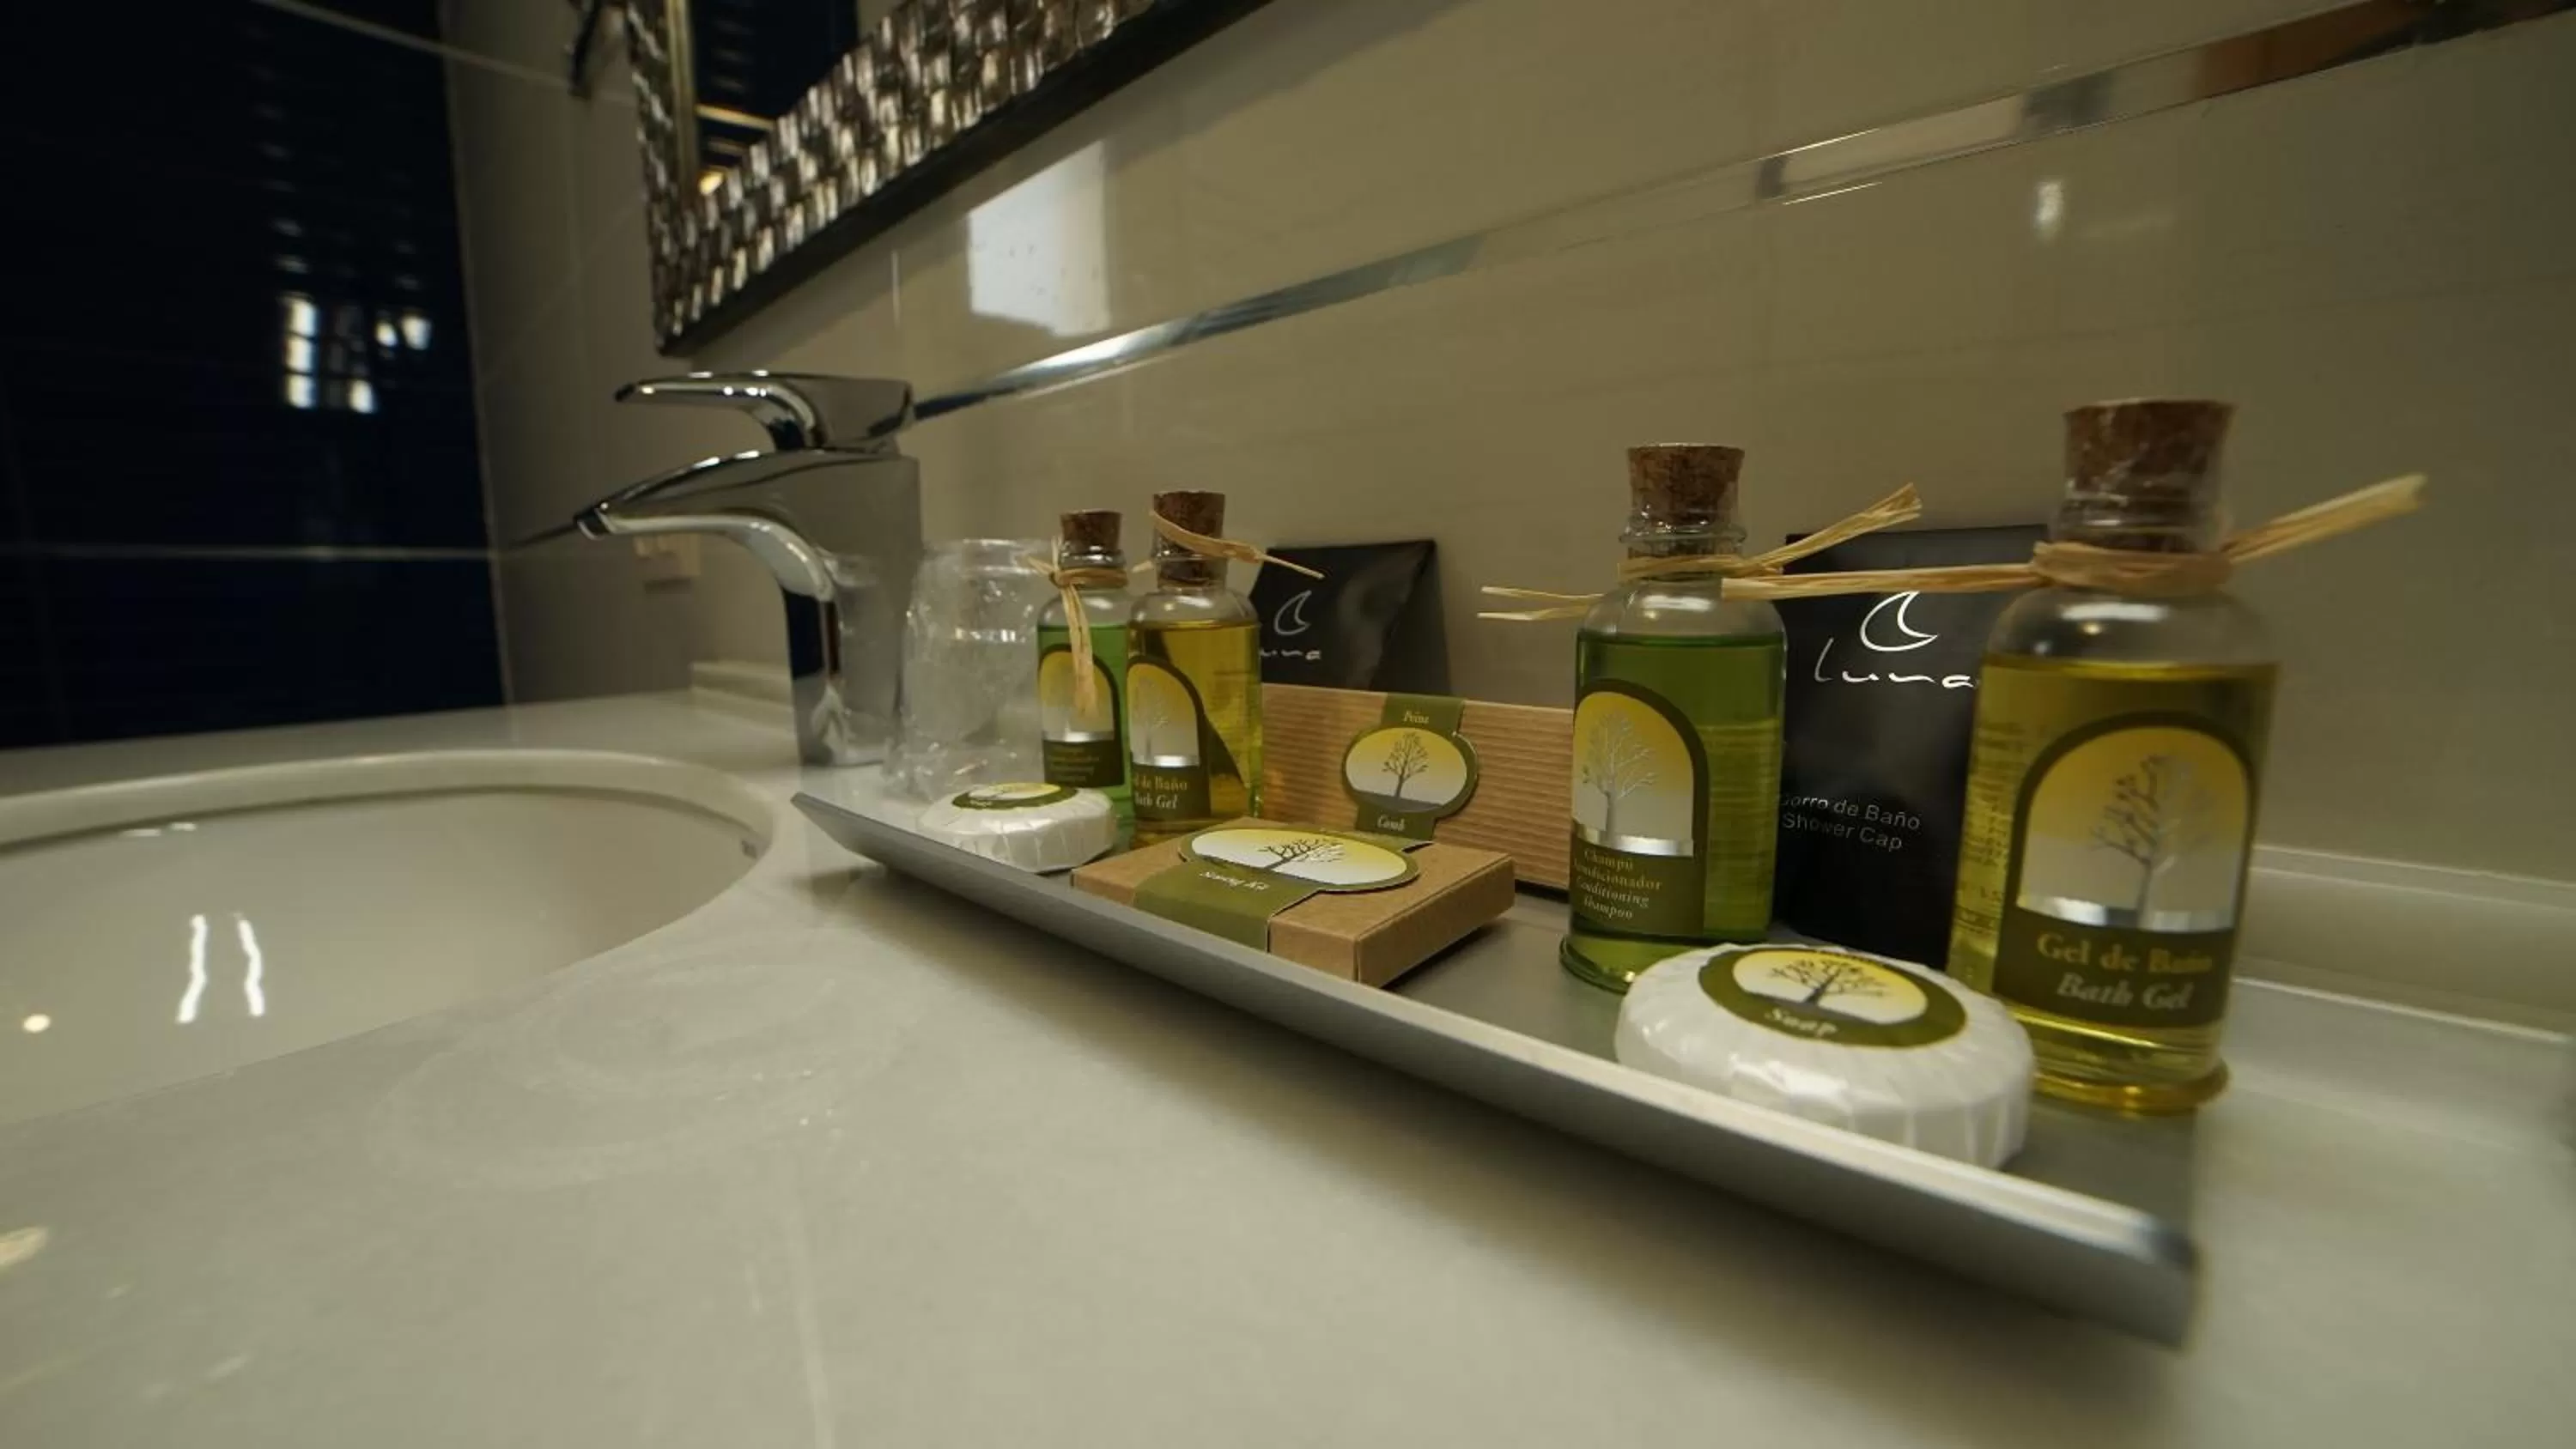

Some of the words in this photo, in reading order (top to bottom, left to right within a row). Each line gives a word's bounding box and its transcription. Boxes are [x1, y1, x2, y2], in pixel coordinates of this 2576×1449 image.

[1259, 648, 1321, 661] una
[1156, 794, 1178, 809] Gel
[1833, 798, 1860, 816] de
[1865, 803, 1921, 830] Baño
[1376, 814, 1406, 832] Comb
[1782, 812, 1856, 839] Shower
[1859, 826, 1903, 852] Cap
[2036, 931, 2092, 966] Gel
[2099, 943, 2140, 972] de
[2057, 972, 2134, 1007] Bath
[2142, 982, 2195, 1011] Gel
[1764, 1008, 1839, 1037] Soap
